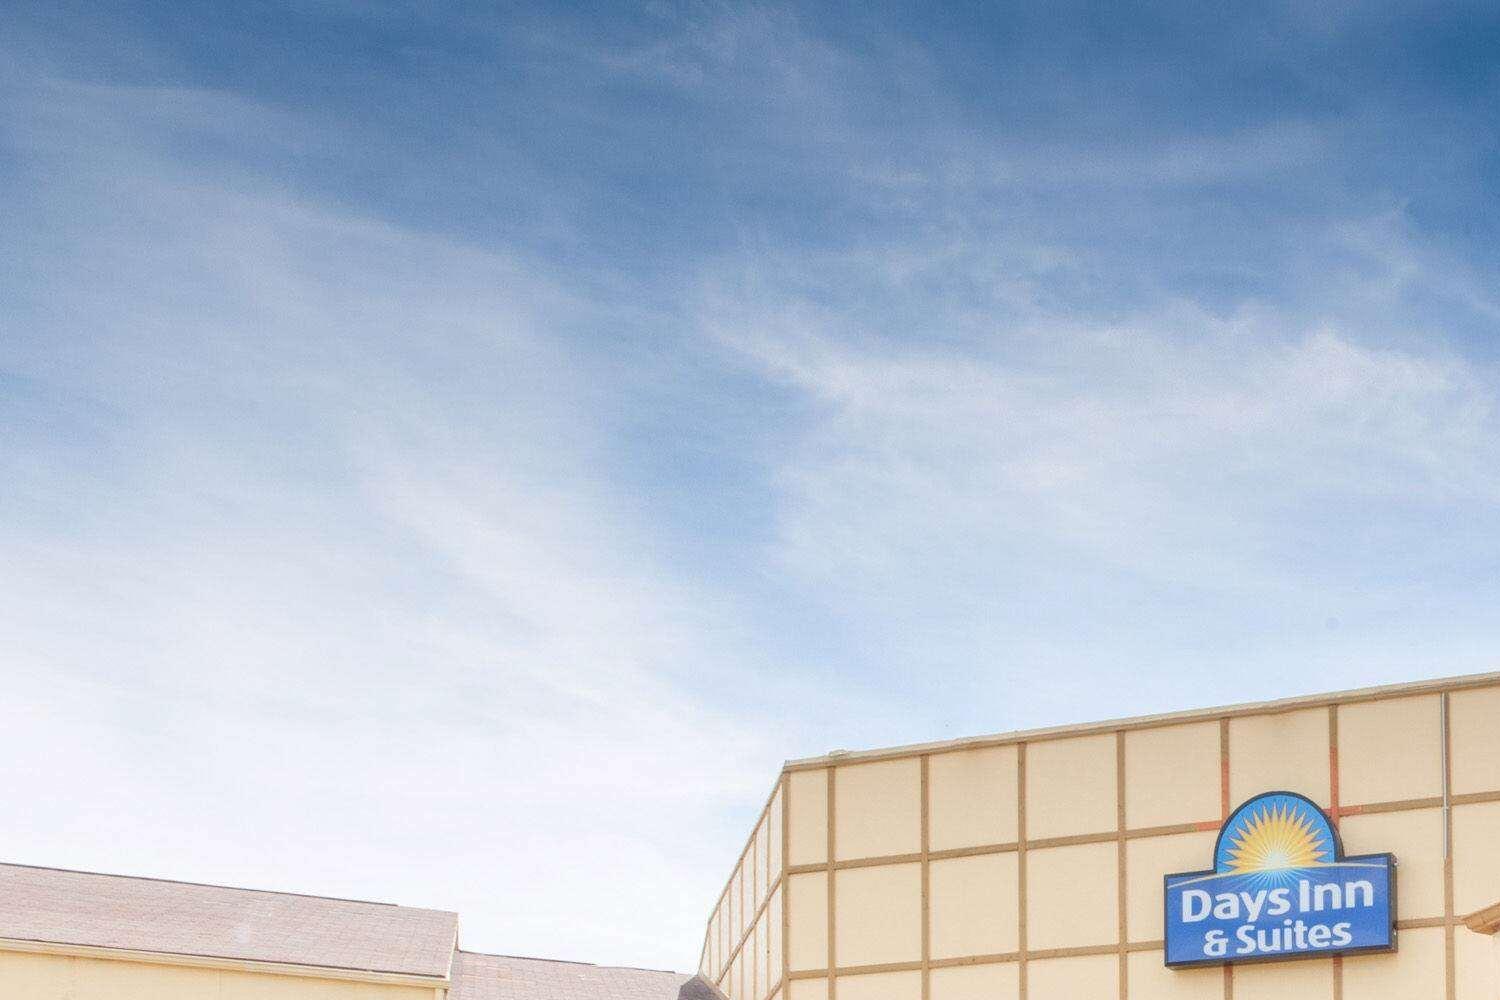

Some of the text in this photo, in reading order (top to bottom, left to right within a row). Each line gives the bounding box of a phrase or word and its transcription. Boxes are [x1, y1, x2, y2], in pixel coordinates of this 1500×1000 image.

[1182, 880, 1374, 922] Days Inn
[1203, 919, 1353, 956] & Suites
